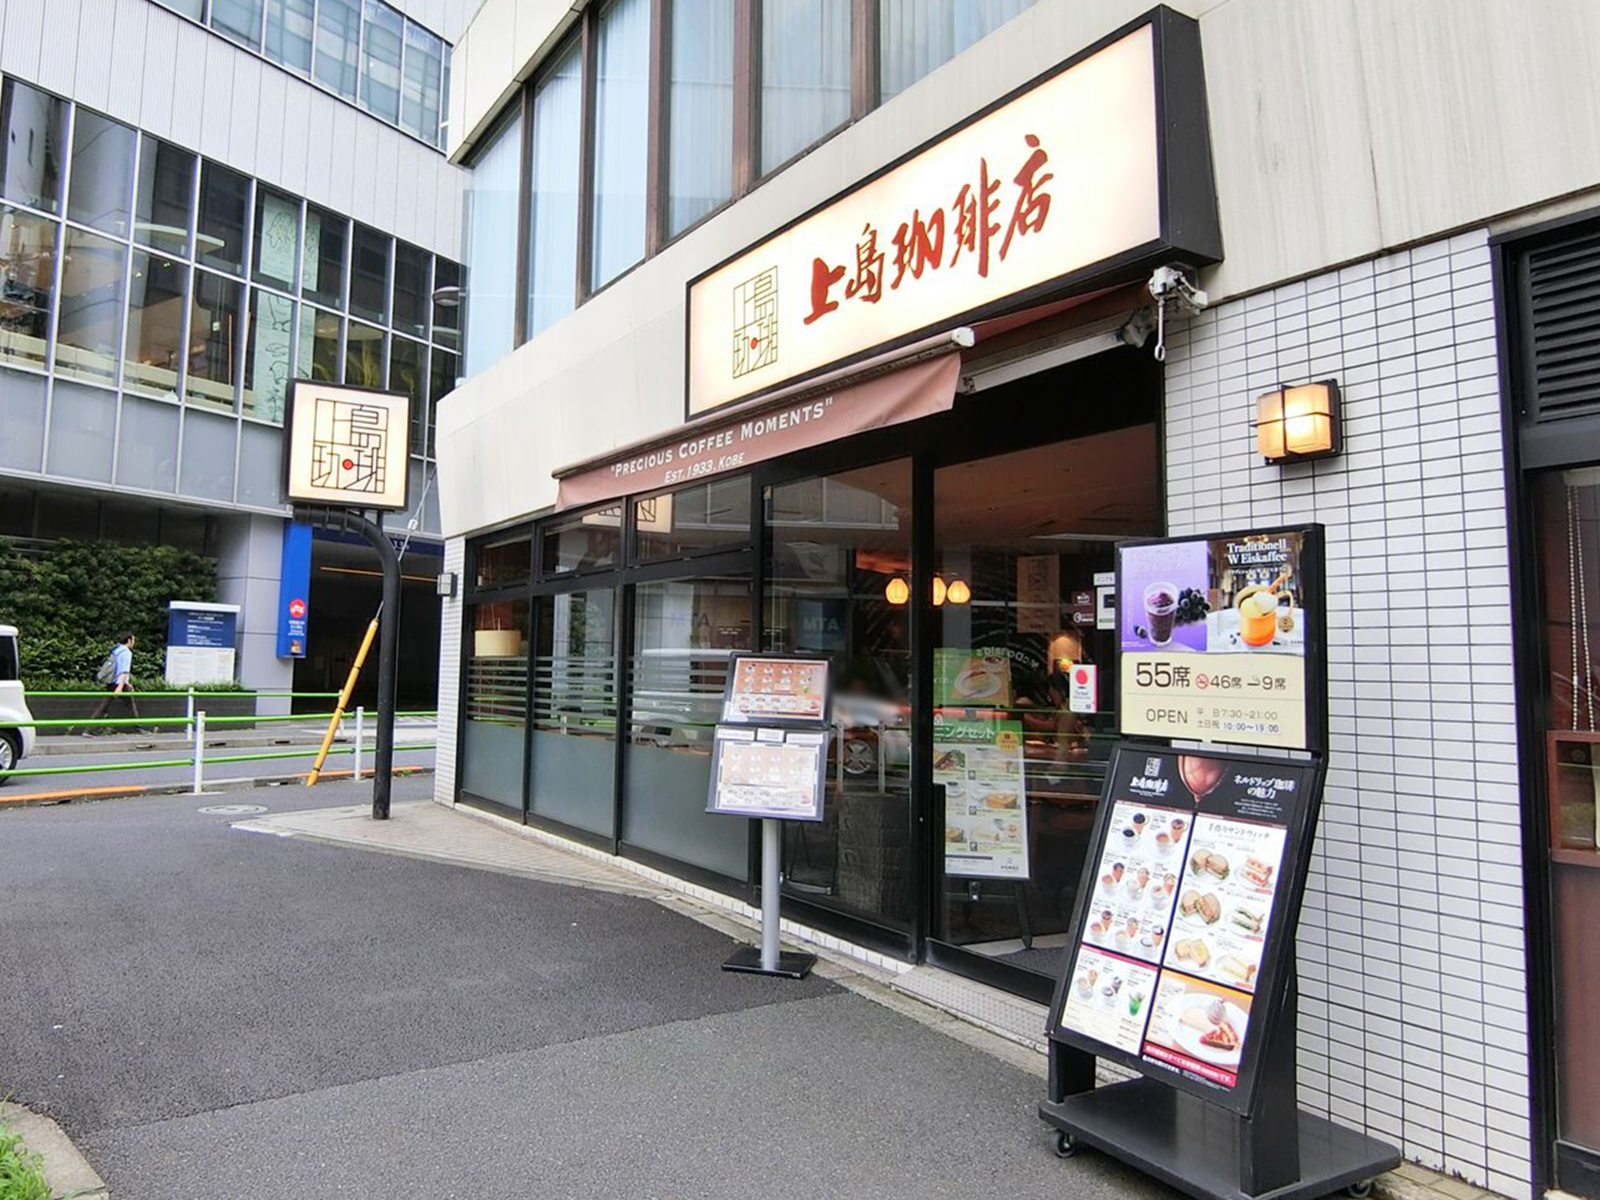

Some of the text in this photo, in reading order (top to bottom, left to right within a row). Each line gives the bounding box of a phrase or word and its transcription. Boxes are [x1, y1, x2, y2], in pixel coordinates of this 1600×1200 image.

[804, 134, 1053, 326] 上島珈琲店
[1226, 538, 1287, 554] Traditionell
[1227, 551, 1287, 565] W Eiskaffee
[1135, 661, 1287, 691] 55席 46席 9席
[1145, 708, 1189, 725] OPEN
[1233, 774, 1296, 791] ネルドリップ珈琲
[1247, 787, 1277, 799] の魅力
